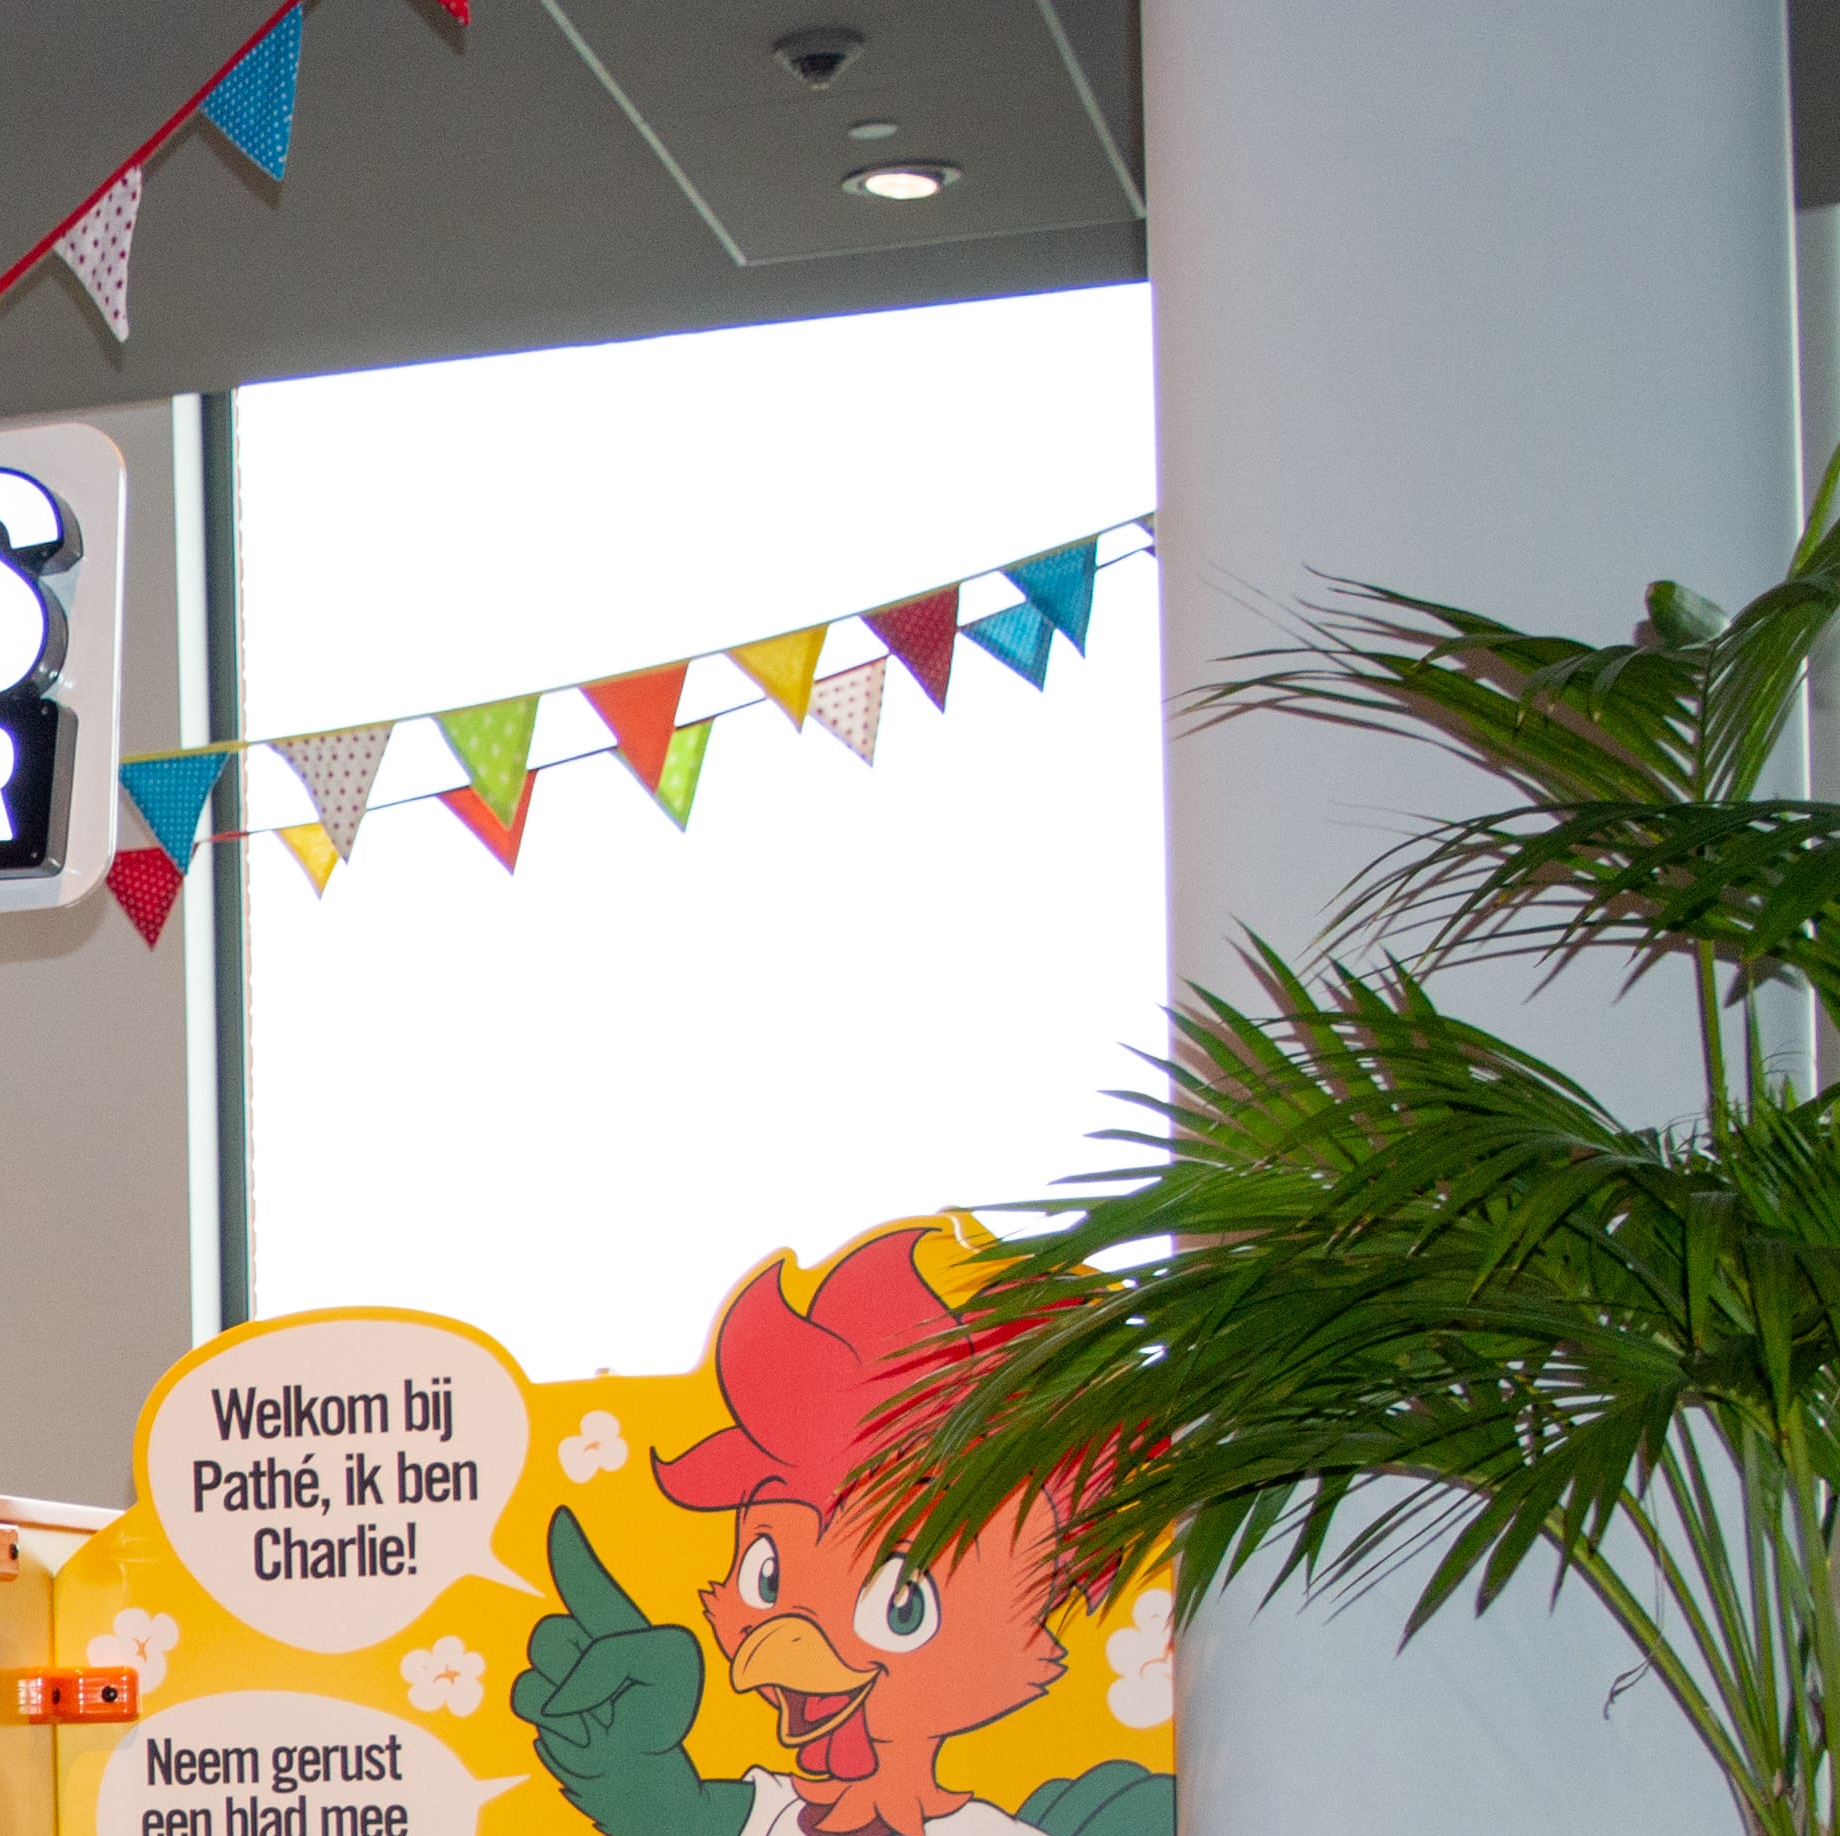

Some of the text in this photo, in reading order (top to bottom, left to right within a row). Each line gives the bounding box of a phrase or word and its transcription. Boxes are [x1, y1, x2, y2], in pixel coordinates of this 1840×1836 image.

[211, 1376, 453, 1442] Welkom bij
[193, 1451, 479, 1516] Pathé, ik ben
[254, 1522, 417, 1581] Charlie!
[147, 1734, 403, 1794] Neem gerust
